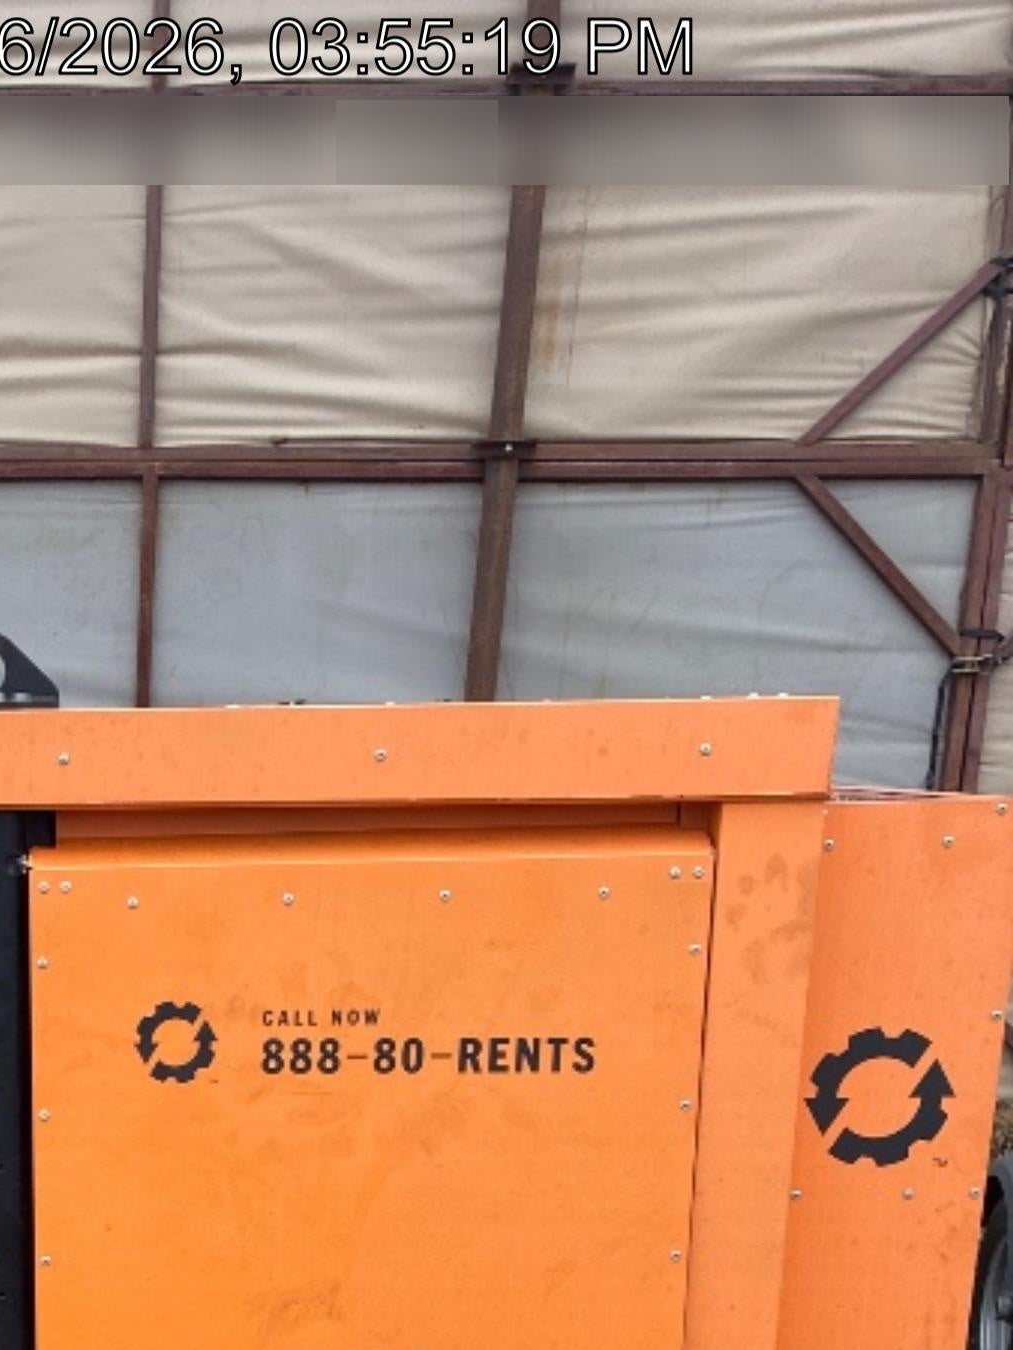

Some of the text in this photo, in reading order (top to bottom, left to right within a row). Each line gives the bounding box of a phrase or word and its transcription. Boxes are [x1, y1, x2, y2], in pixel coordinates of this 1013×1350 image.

[261, 1008, 380, 1026] CALL NOW
[261, 1036, 596, 1075] 888-80-RENTS
